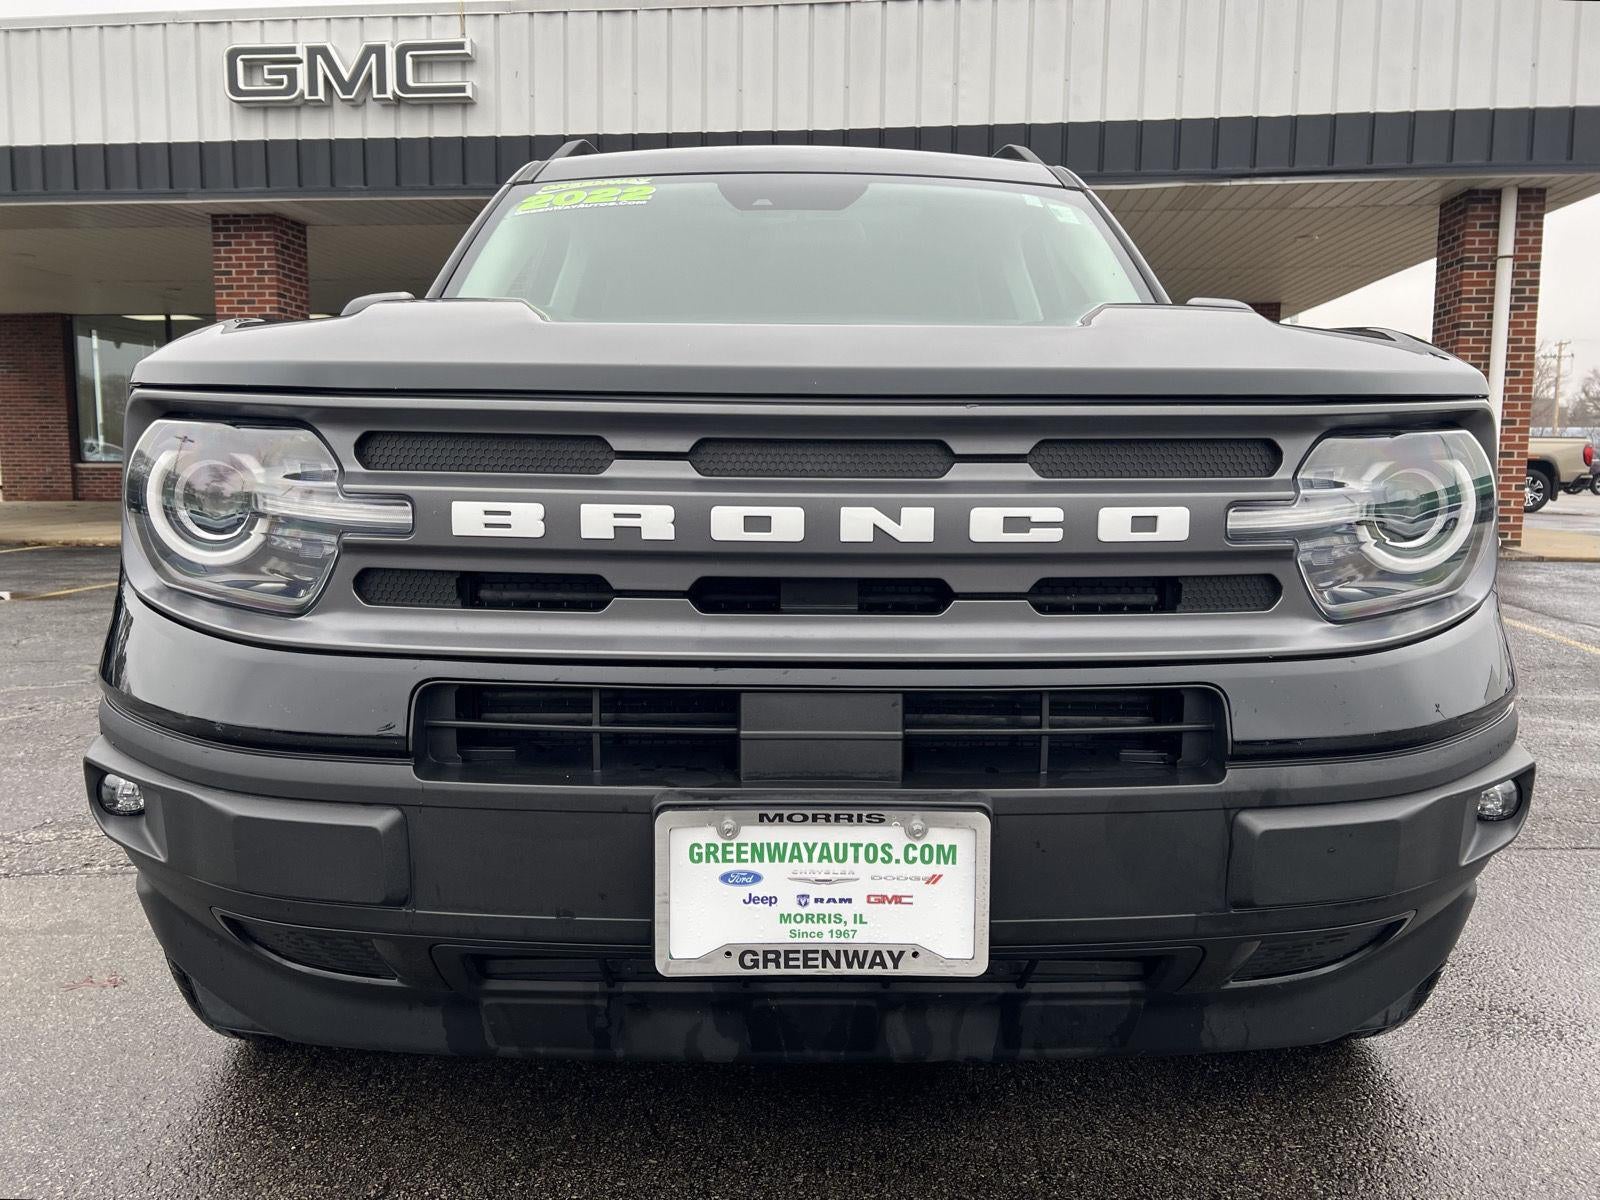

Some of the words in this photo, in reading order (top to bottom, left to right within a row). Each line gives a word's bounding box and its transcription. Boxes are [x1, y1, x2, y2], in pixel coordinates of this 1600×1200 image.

[224, 38, 477, 105] GMC
[516, 185, 656, 211] 2022
[451, 500, 1190, 543] BRONCO
[758, 812, 886, 824] MORRIS
[688, 842, 958, 865] GREENWAYAUTOS.COM
[724, 871, 757, 885] Ford
[870, 874, 932, 882] DODGE
[742, 893, 778, 907] Jeep
[866, 894, 914, 905] GMC
[779, 913, 848, 927] MORRIS,
[853, 914, 868, 924] IL
[788, 929, 824, 939] Since
[828, 929, 858, 939] 1967
[738, 949, 906, 970] GREENWAY
